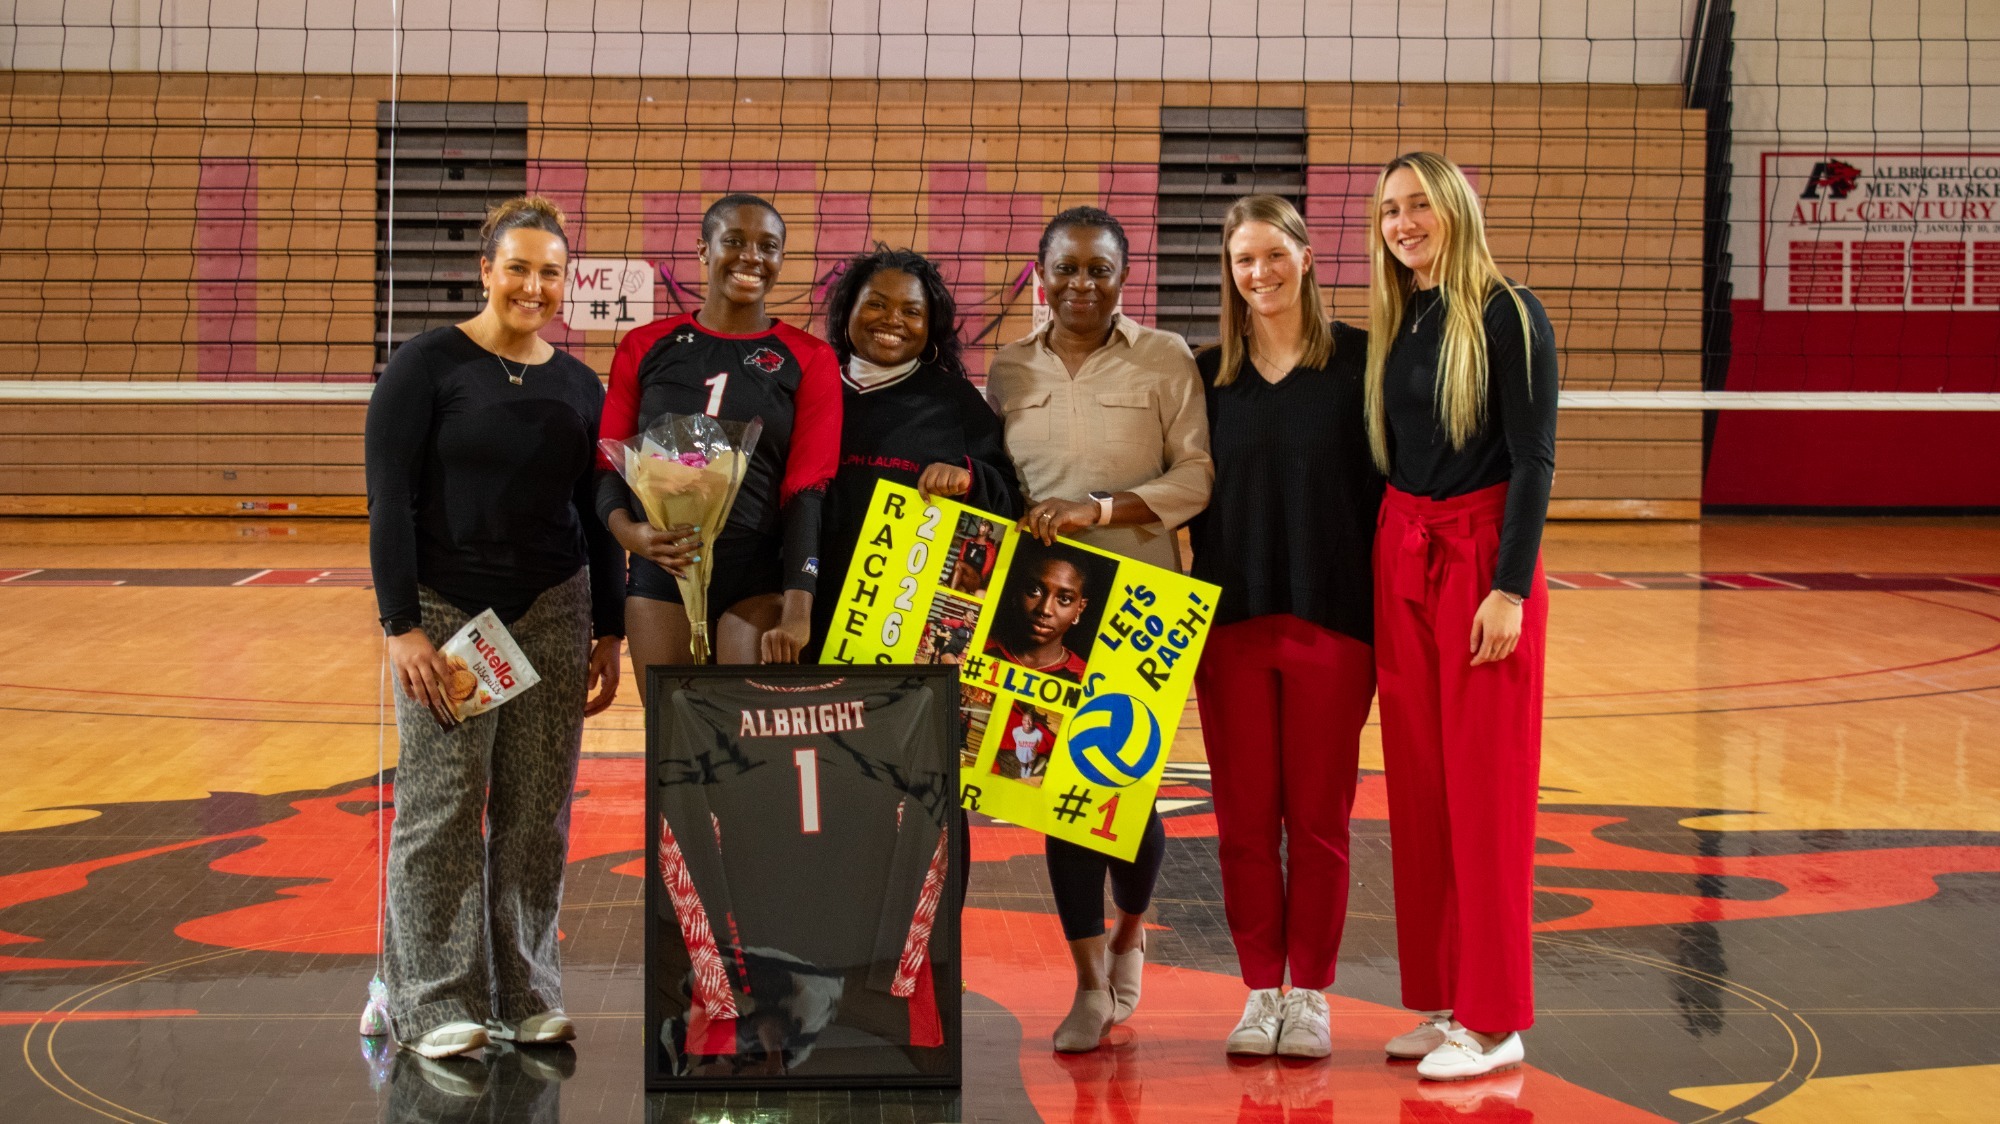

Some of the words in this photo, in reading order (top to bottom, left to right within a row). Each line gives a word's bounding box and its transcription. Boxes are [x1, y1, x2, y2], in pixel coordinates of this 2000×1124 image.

[1865, 182, 1928, 198] MEN'S
[1875, 166, 1967, 179] ALBRIGHT
[1973, 166, 2000, 179] CO
[1788, 201, 1996, 227] ALL-CENTURY
[1926, 224, 1972, 235] JANUARY
[575, 268, 613, 290] WE
[590, 295, 635, 322] #1
[704, 371, 729, 418] 1
[867, 455, 920, 473] LAUREN
[881, 505, 942, 647] 2026
[1098, 584, 1156, 652] LET'S
[1130, 615, 1164, 652] GO
[467, 628, 516, 690] nutella
[1136, 592, 1210, 692] RACH!
[472, 661, 502, 695] biscuits
[739, 700, 866, 738] ALBRIGHT
[793, 747, 822, 834] 1
[1053, 785, 1122, 842] #1
